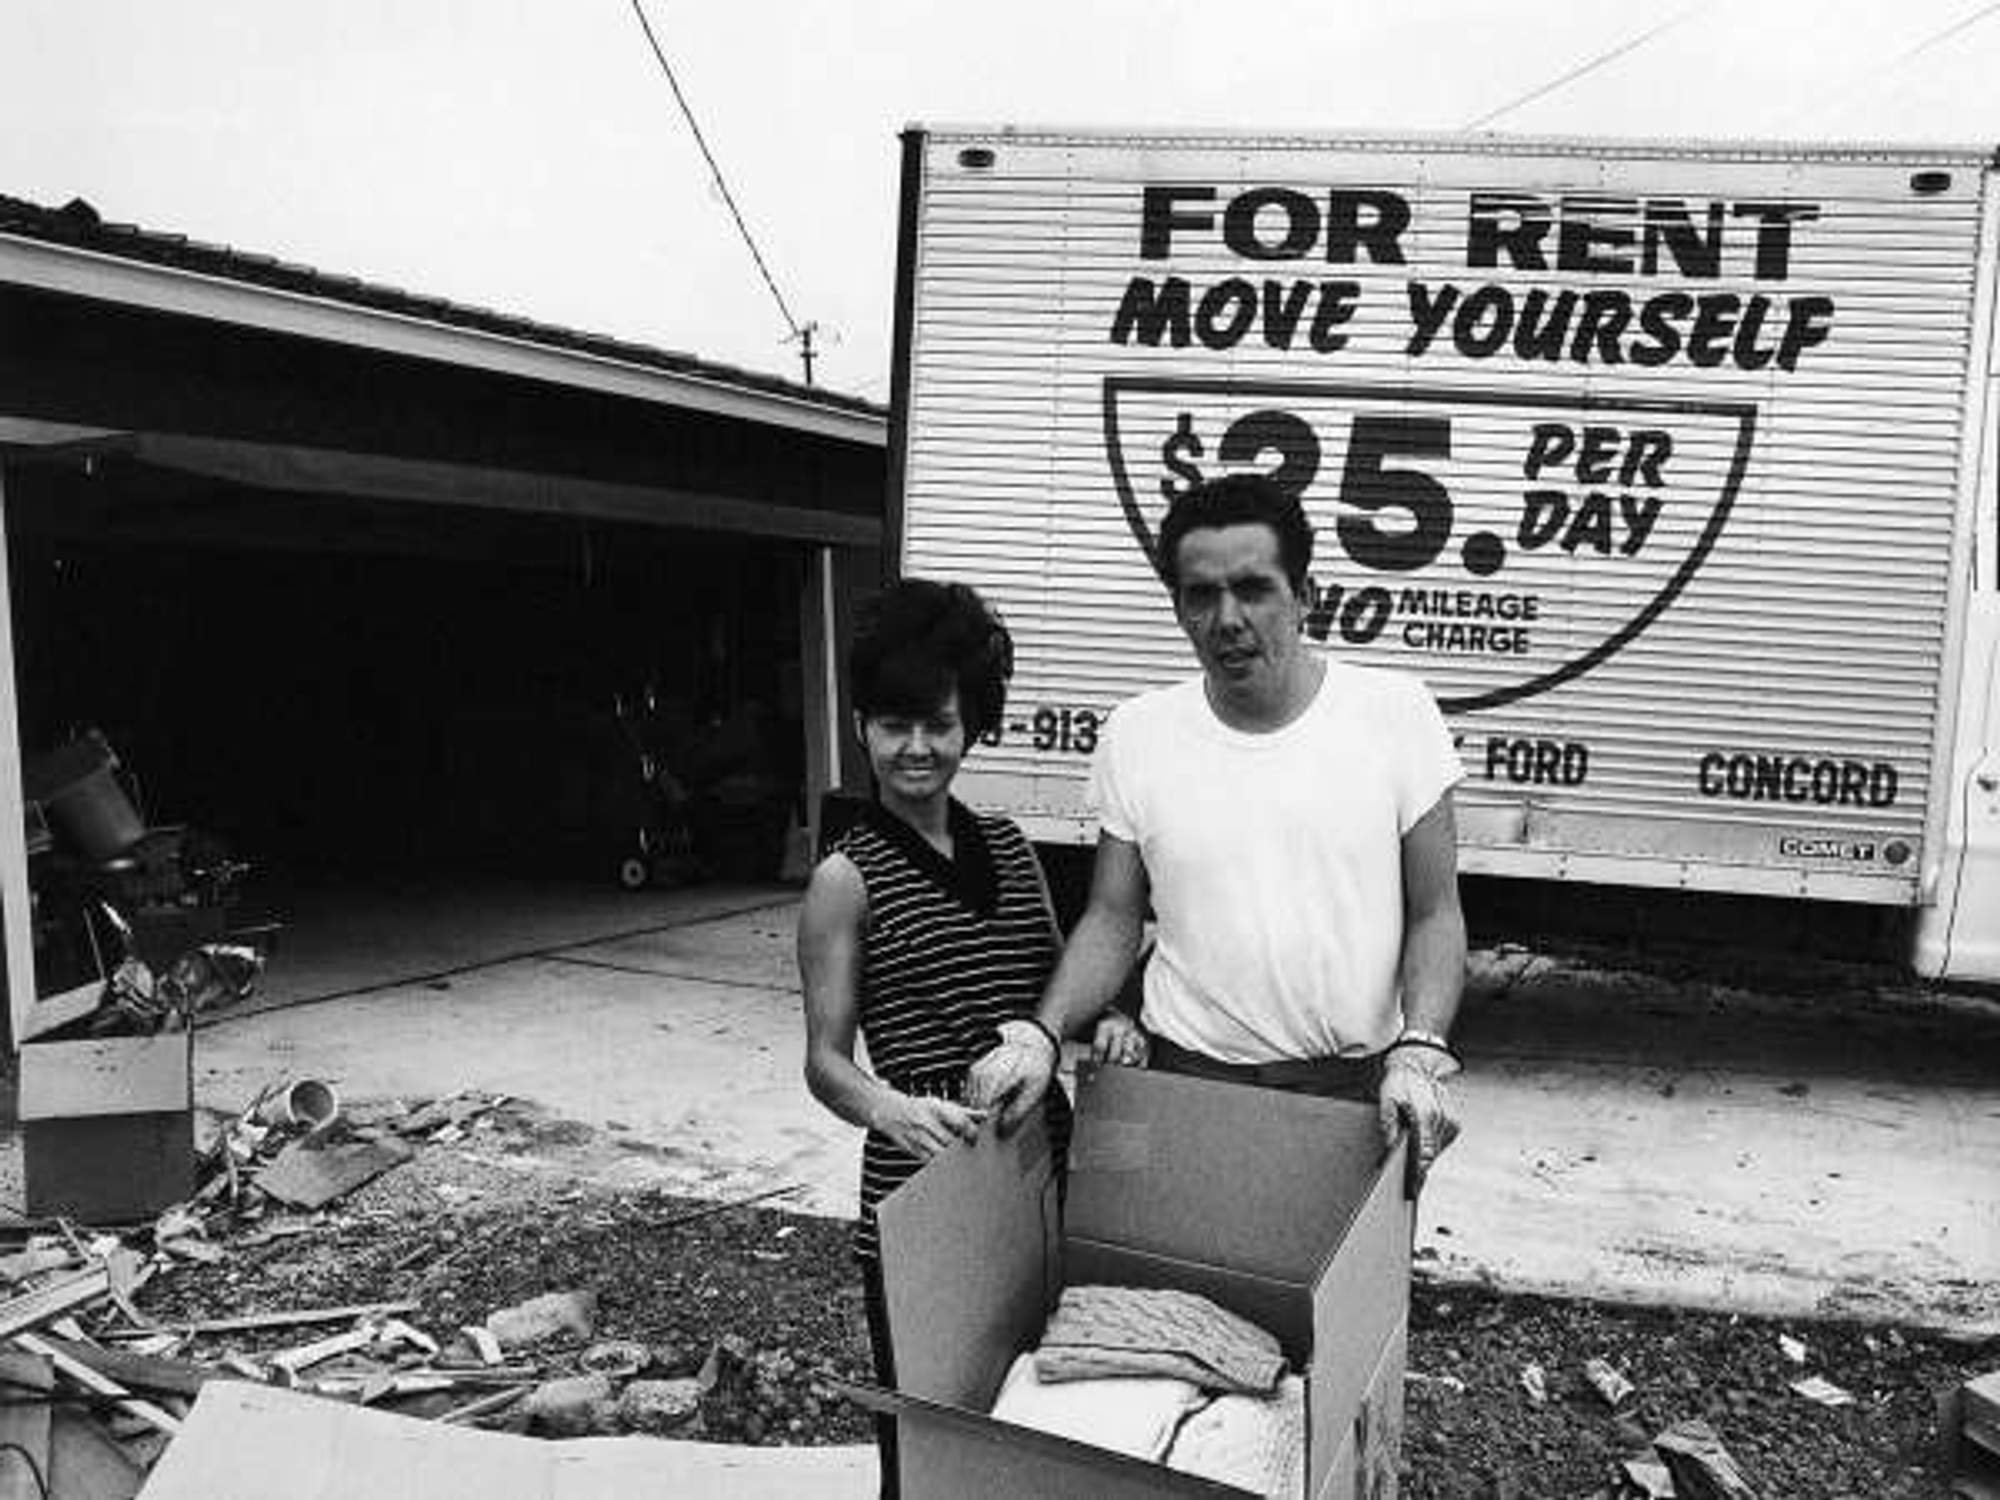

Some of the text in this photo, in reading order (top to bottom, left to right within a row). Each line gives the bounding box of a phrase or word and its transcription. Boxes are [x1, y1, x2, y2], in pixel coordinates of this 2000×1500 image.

[1140, 185, 1820, 281] FOR RENT
[1110, 276, 1835, 372] MOVE YOURSELF
[1523, 423, 1673, 489] PER
[1516, 489, 1665, 557] DAY
[1396, 587, 1539, 621] MILEAGE
[1402, 621, 1530, 654] CHARGE
[1486, 737, 1589, 786] FORD
[1699, 751, 1899, 808] CONCORD
[1781, 838, 1875, 860] COMET
